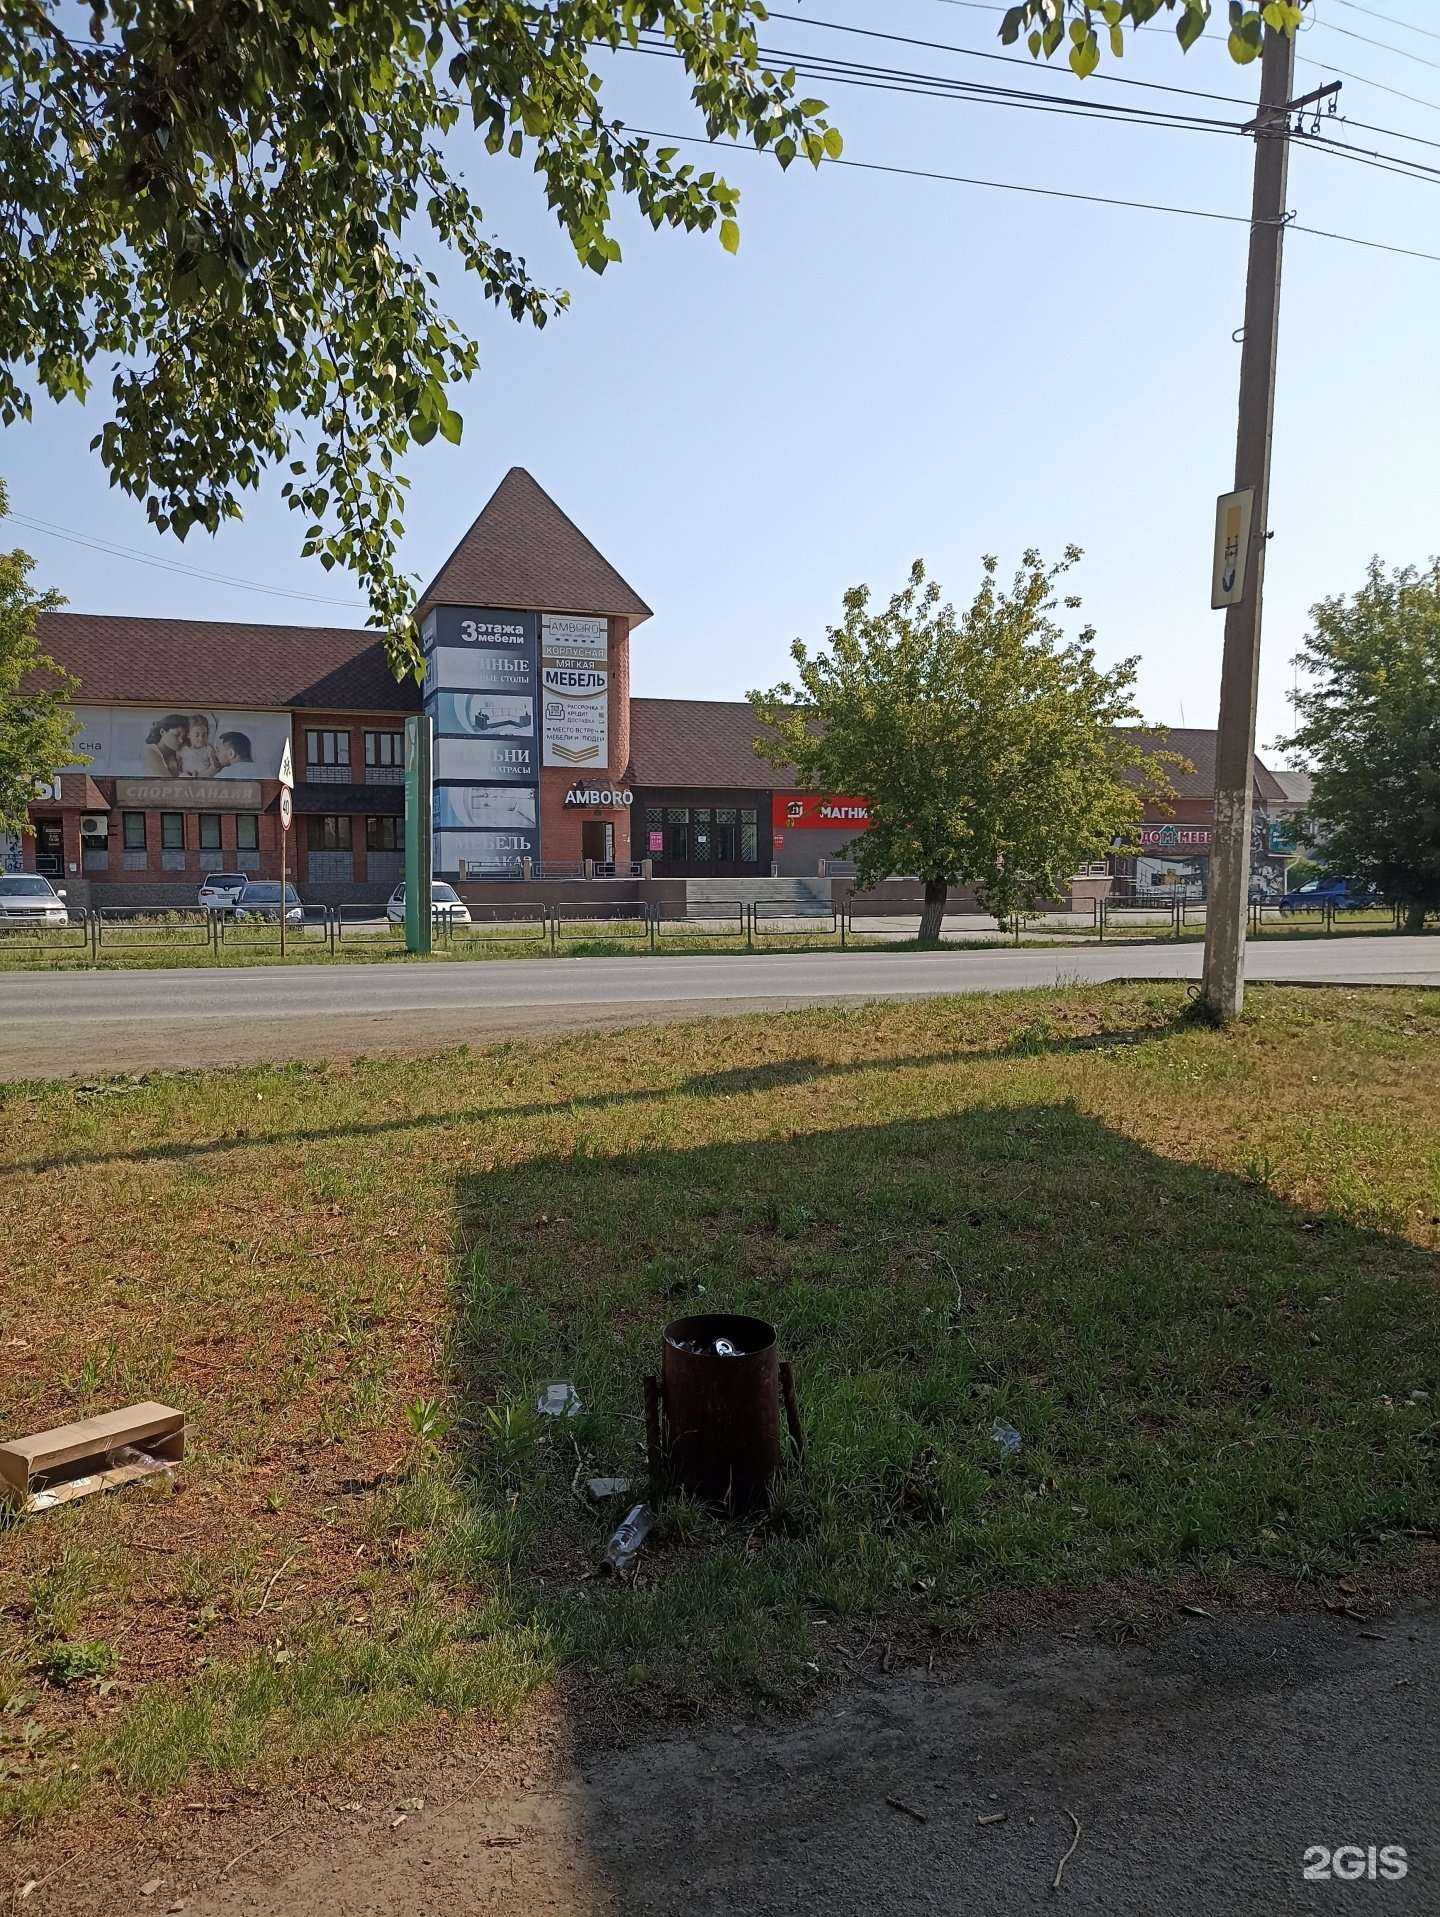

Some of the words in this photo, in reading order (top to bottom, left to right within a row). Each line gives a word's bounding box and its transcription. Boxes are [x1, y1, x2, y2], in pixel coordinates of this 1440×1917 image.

[461, 621, 477, 641] 3
[477, 623, 524, 634] этажа
[478, 633, 524, 644] мебели
[546, 646, 604, 657] КОРПУСНАЯ
[556, 659, 595, 669] МЯГКАЯ
[545, 671, 606, 688] МЕБЕЛЬ
[282, 799, 290, 816] 40
[820, 806, 872, 819] МАГНИ
[1141, 830, 1174, 845] ДОМ
[1178, 831, 1213, 844] МЕБЕ
